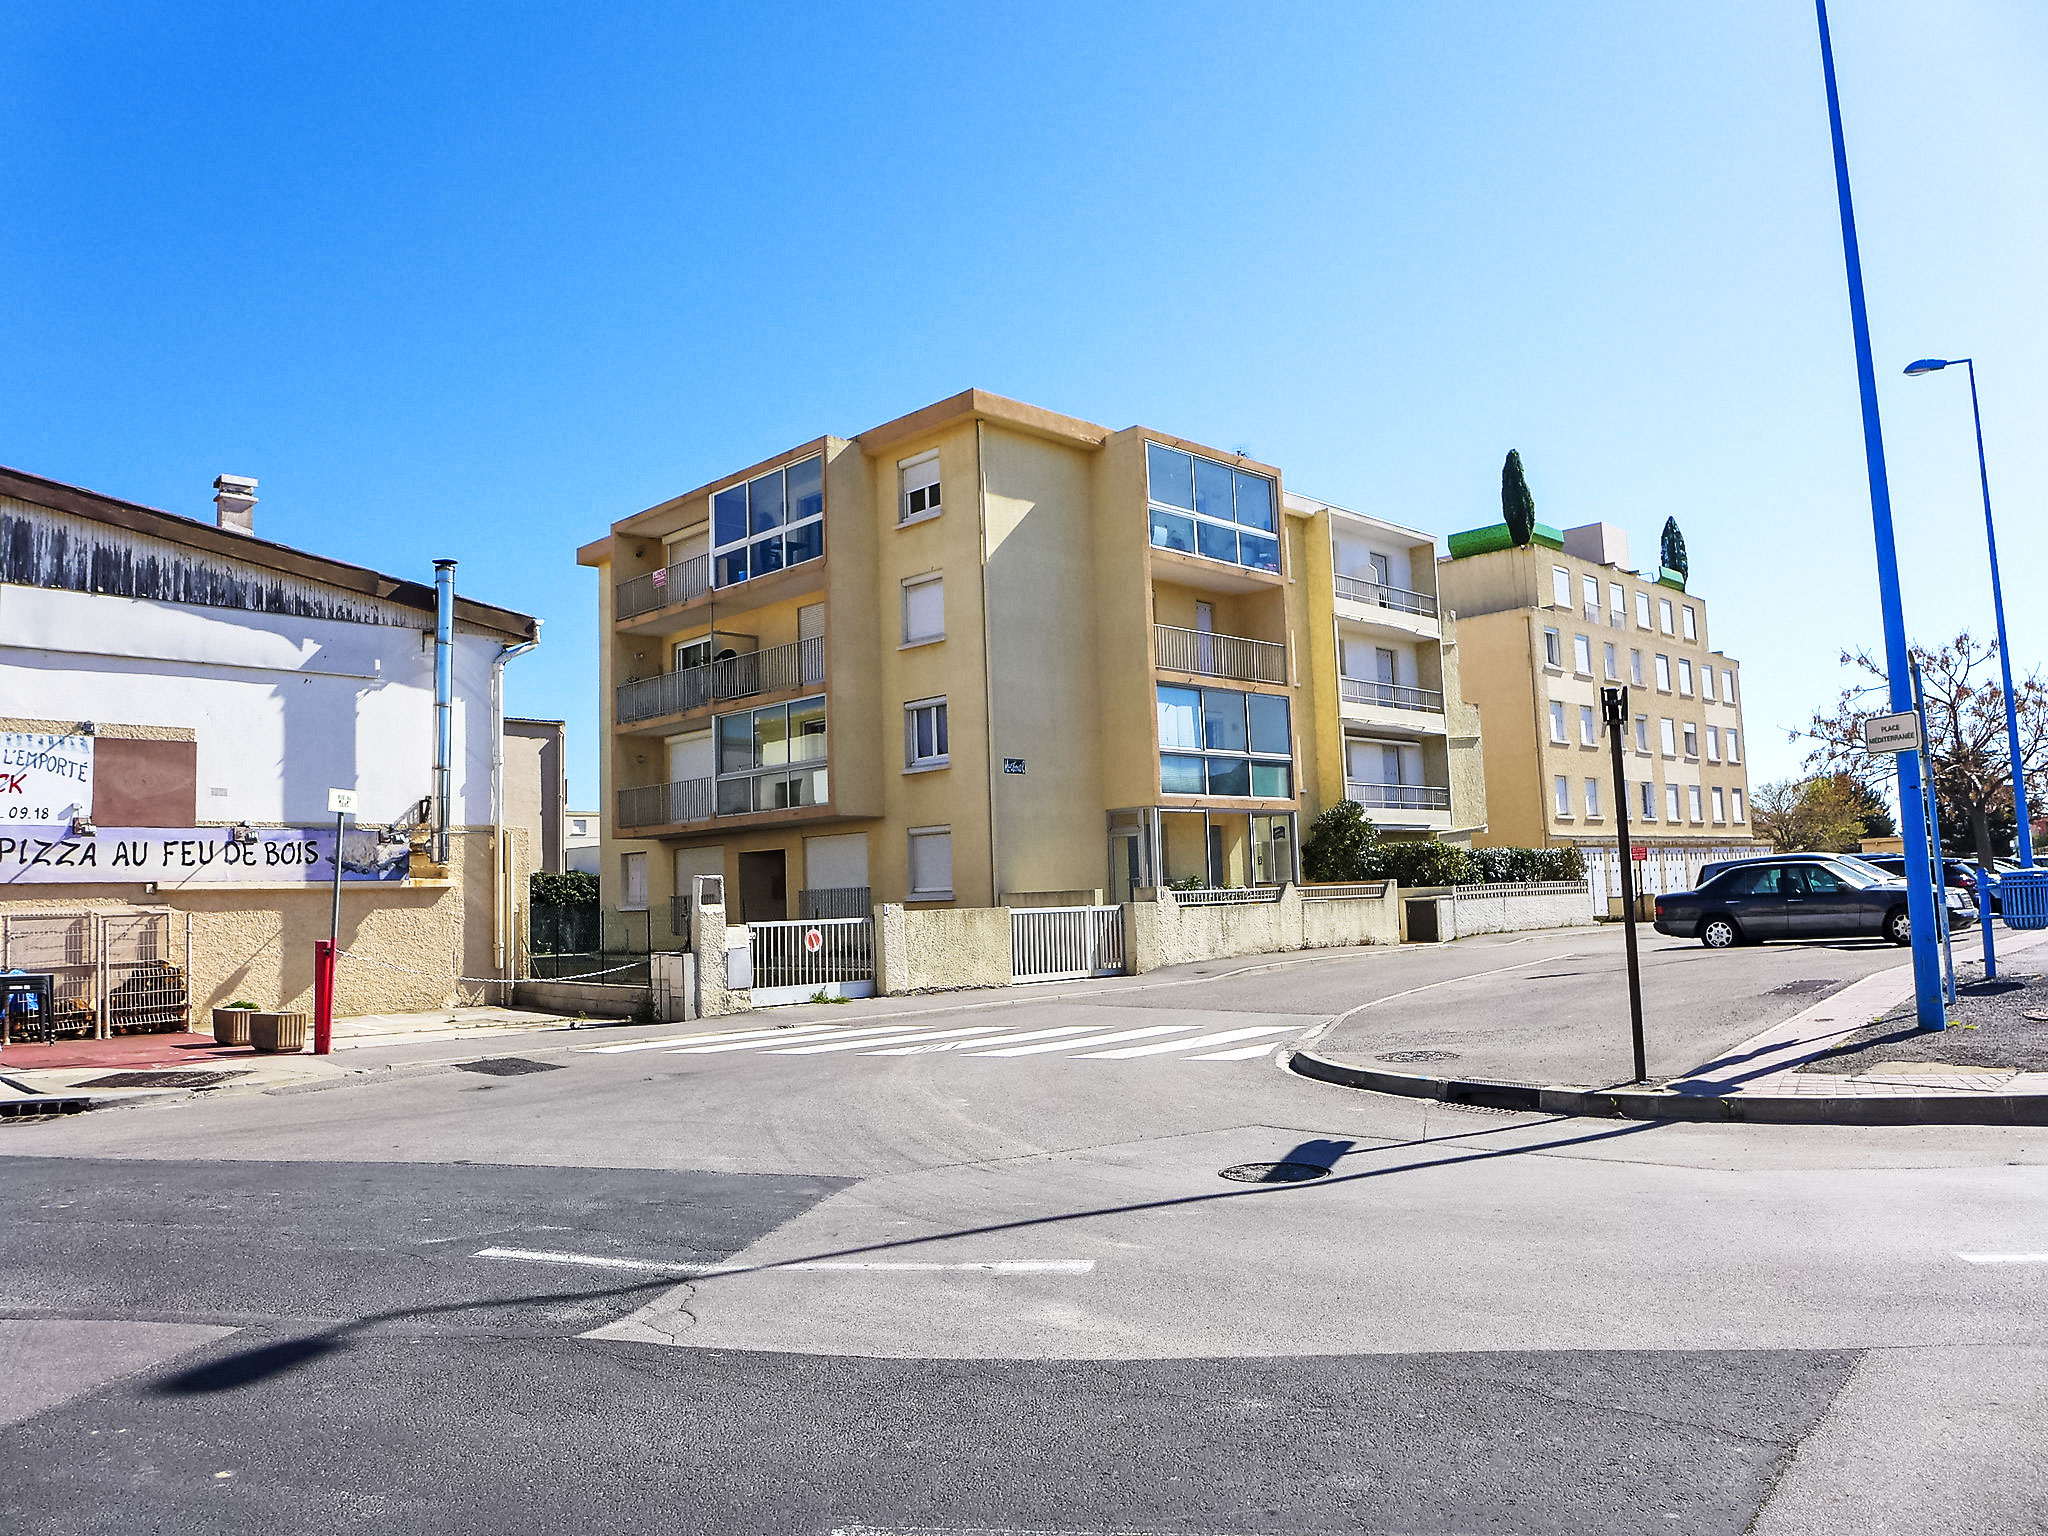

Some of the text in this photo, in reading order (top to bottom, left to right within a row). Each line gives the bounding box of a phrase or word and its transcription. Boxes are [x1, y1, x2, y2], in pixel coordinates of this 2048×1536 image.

[1880, 724, 1900, 732] PLACE
[3, 748, 89, 783] L'EMPORTÉ
[0, 837, 319, 867] PIZZA AU FEU DE BOIS
